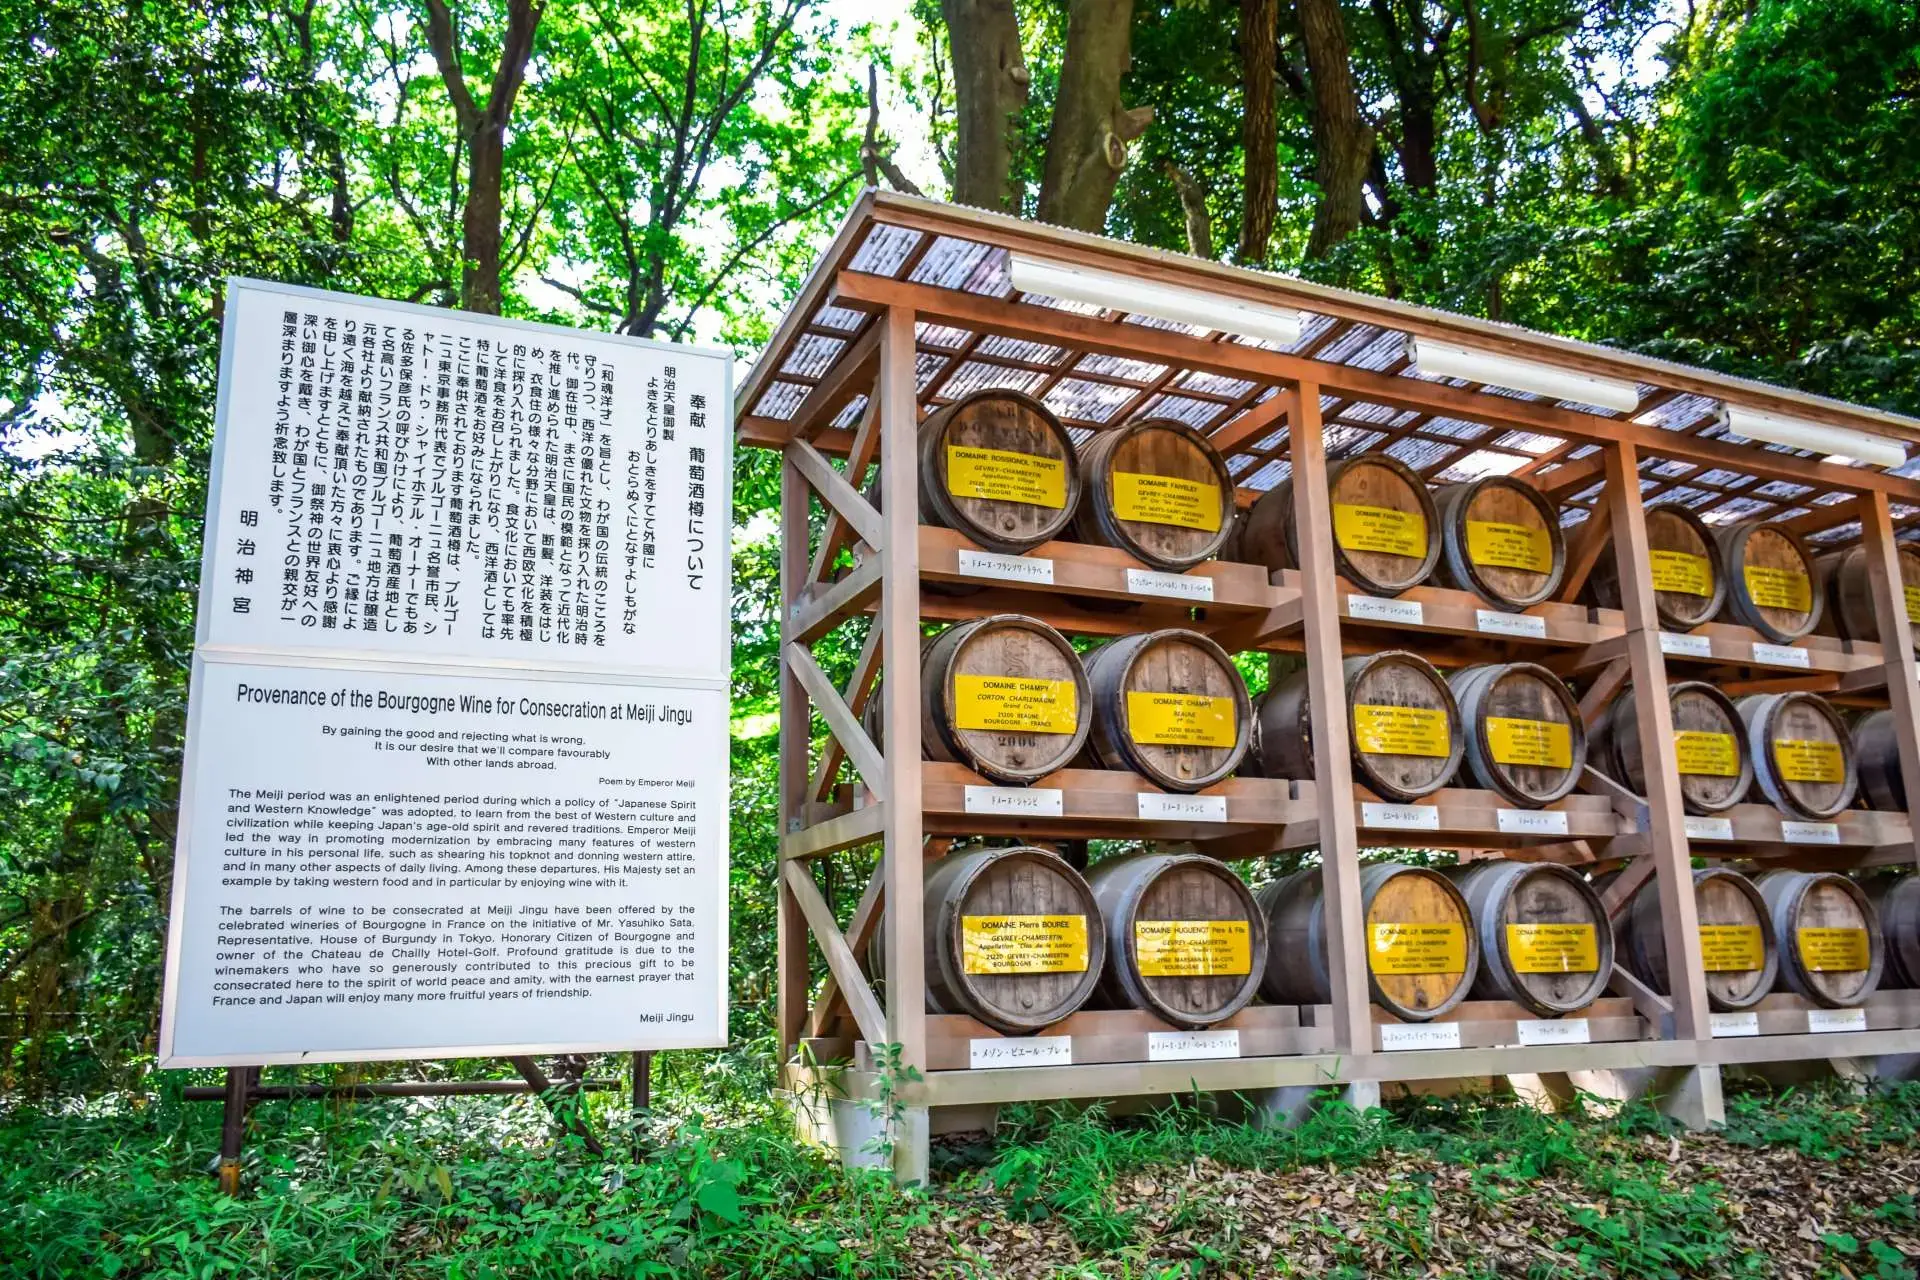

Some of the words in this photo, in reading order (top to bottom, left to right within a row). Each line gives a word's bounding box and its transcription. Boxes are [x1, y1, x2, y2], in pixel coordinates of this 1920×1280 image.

[662, 365, 677, 442] 明治天皇御製
[689, 394, 707, 429] 奉献
[955, 451, 988, 461] DOMAINE
[1138, 479, 1168, 488] DOMAINE
[686, 446, 706, 591] 葡萄酒樽について
[232, 509, 259, 614] 明治神宮
[983, 681, 1017, 690] DOMAINE
[1019, 683, 1049, 692] CHAMPY
[237, 683, 327, 707] Provenance
[330, 688, 347, 707] of
[349, 689, 373, 709] the
[377, 690, 456, 715] Bourgogne
[459, 694, 493, 715] Wine
[496, 696, 516, 715] for
[519, 697, 607, 720] Consecration
[610, 703, 623, 720] at
[626, 703, 655, 725] Meiji
[658, 704, 693, 726] Jingu
[1153, 698, 1183, 706] DOMAINE
[983, 718, 1021, 726] BOURGOGNE
[322, 725, 338, 736] By
[340, 726, 382, 738] gaining
[384, 727, 404, 738] the
[405, 729, 435, 740] good
[437, 730, 459, 740] and
[461, 731, 509, 743] rejecting
[511, 733, 537, 743] what
[539, 734, 549, 744] is
[374, 740, 383, 751] It
[385, 741, 395, 751] is
[397, 743, 417, 752] our
[419, 742, 455, 753] desire
[457, 744, 479, 754] that
[508, 747, 555, 758] compare
[556, 747, 611, 760] favourably
[426, 756, 451, 767] With
[453, 757, 483, 768] other
[485, 758, 514, 769] lands
[516, 760, 557, 770] abroad.
[598, 777, 624, 786] Poem
[625, 777, 636, 787] by
[638, 778, 674, 788] Emperor
[675, 779, 695, 789] Meiji
[228, 788, 252, 799] The
[255, 789, 284, 801] Meiji
[287, 790, 326, 801] period
[329, 793, 352, 802] was
[355, 793, 370, 802] an
[373, 792, 441, 804] enlightened
[443, 794, 480, 805] period
[482, 795, 518, 807] during
[520, 796, 551, 806] which
[554, 798, 561, 807] a
[564, 797, 596, 809] policy
[598, 798, 610, 808] of
[670, 800, 697, 811] Spirit
[219, 905, 243, 916] The
[249, 905, 293, 916] barrels
[299, 905, 313, 915] of
[318, 905, 346, 915] wine
[352, 905, 365, 915] to
[370, 905, 387, 915] be
[392, 905, 464, 915] consecrated
[469, 905, 481, 915] at
[487, 904, 513, 916] Meiji
[518, 905, 549, 916] Jingu
[554, 905, 580, 915] have
[585, 905, 612, 915] been
[617, 904, 656, 914] offered
[661, 905, 674, 916] by
[678, 905, 695, 914] the
[981, 921, 1017, 929] DOMAINE
[1019, 921, 1040, 929] Pierre
[991, 934, 1063, 942] GEVREY-CHAMBERTIN
[993, 960, 1032, 968] BOURGOGNE
[639, 1013, 664, 1024] Meiji
[665, 1012, 694, 1023] Jingu
